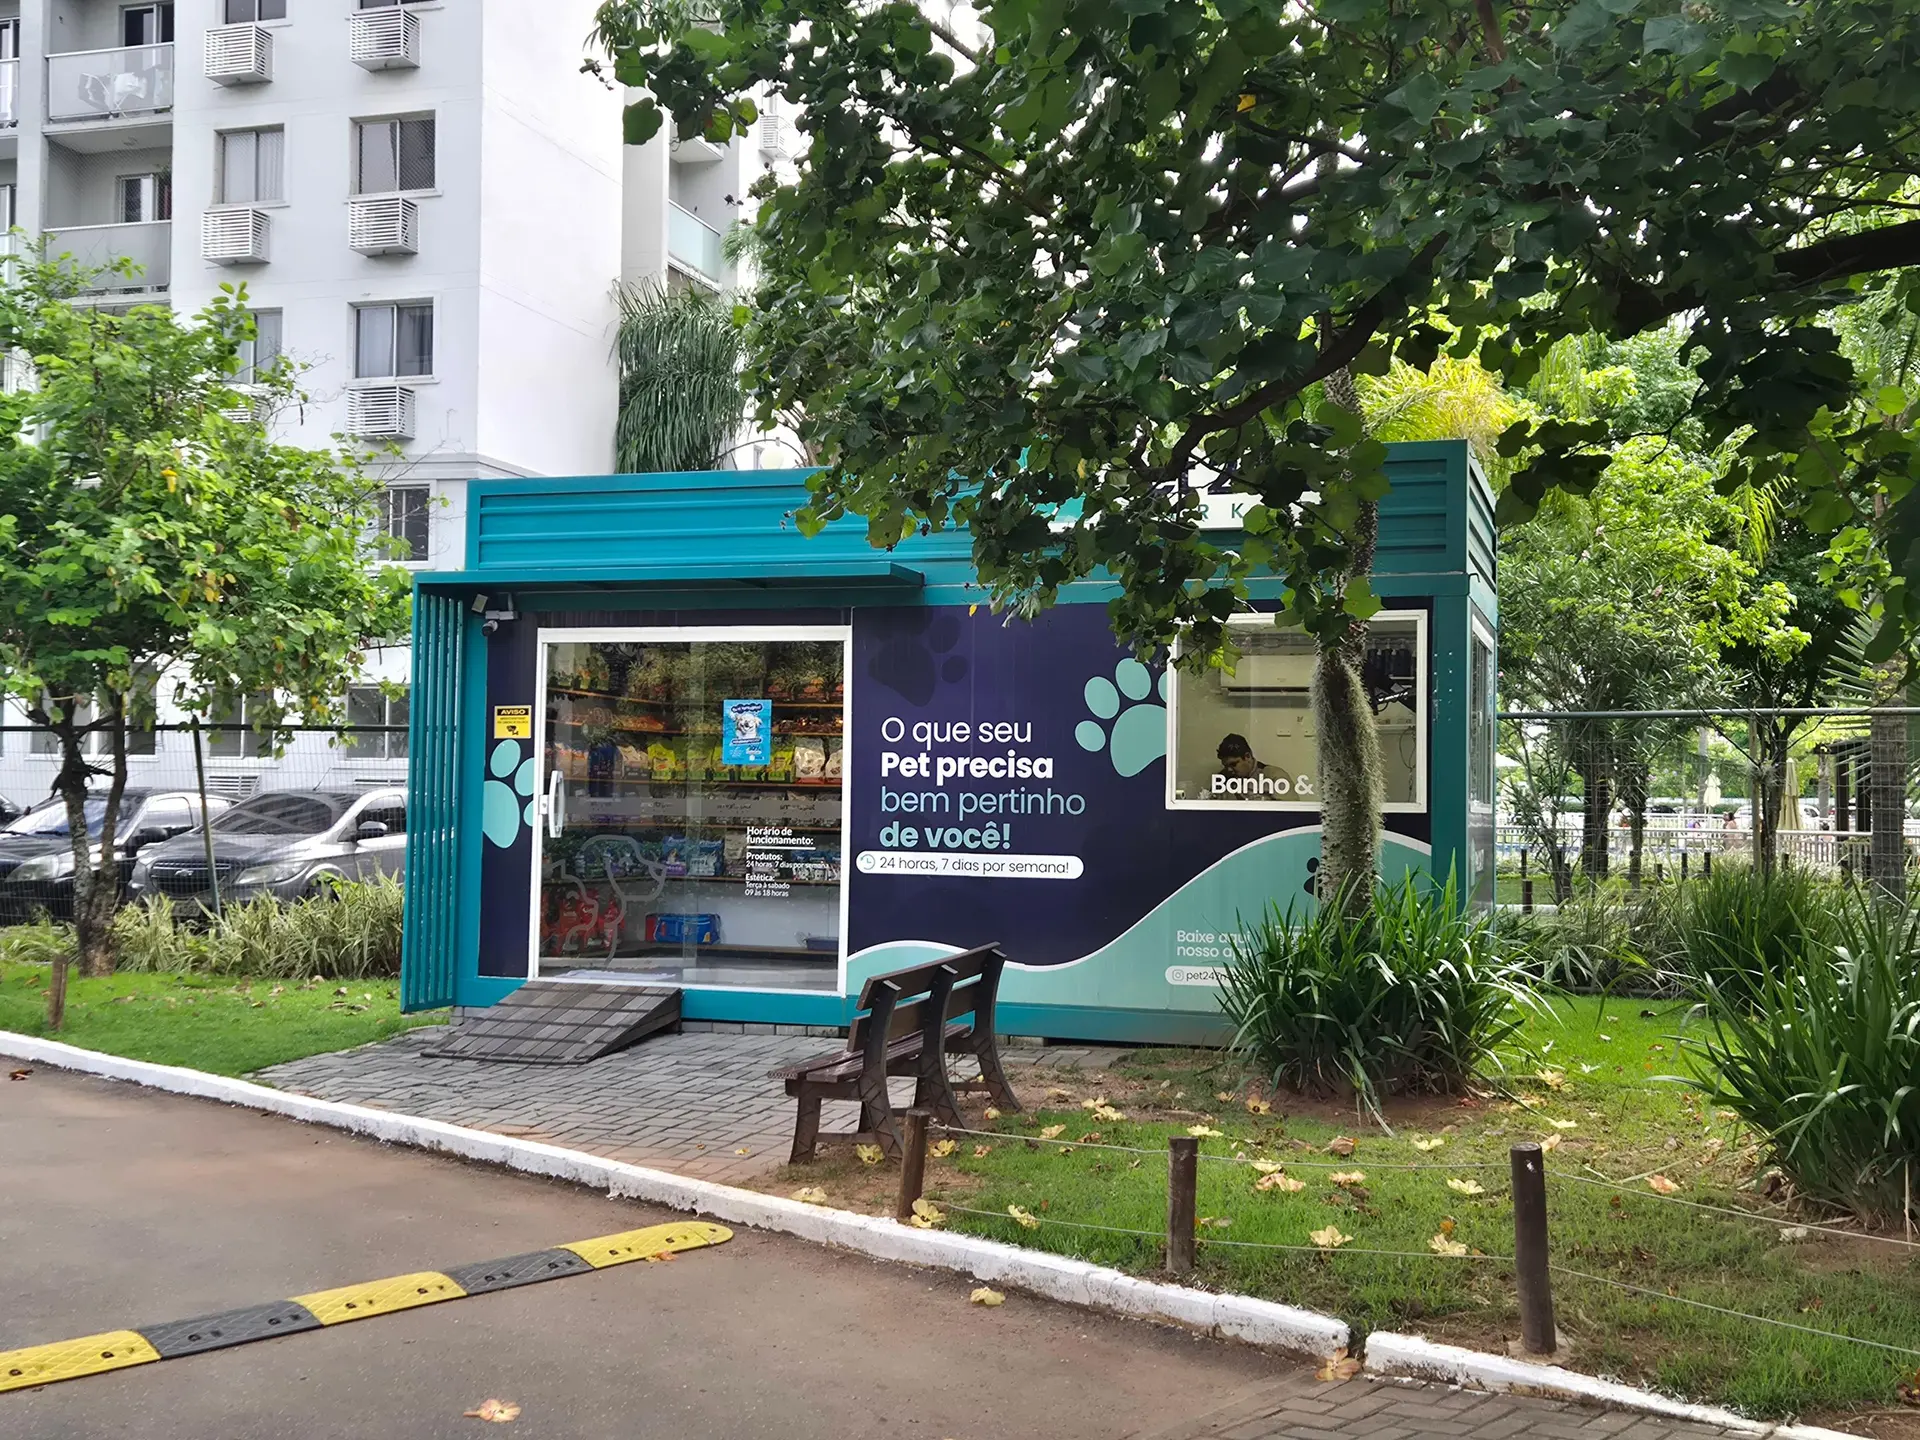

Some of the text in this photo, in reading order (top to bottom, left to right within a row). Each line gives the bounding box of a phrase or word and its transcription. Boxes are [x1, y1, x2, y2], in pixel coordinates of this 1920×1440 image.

[881, 717, 1032, 751] O que seu
[881, 749, 1054, 787] Pet precisa
[1211, 773, 1315, 795] Banho &
[880, 785, 1086, 822] bem pertinho
[746, 826, 792, 836] Horário de
[879, 820, 1012, 850] de você!
[746, 835, 815, 845] funcionamento:
[746, 852, 783, 860] Produtos:
[745, 860, 754, 868] 24
[774, 860, 780, 868] 7
[780, 861, 793, 869] dias
[793, 862, 805, 870] por
[880, 856, 1069, 875] 24 horas, 7 dias por semana!
[745, 873, 776, 882] Estética:
[745, 881, 763, 890] Terça
[744, 888, 754, 896] 09
[762, 889, 771, 897] 18
[771, 889, 789, 898] horas
[1176, 929, 1215, 944] Baixe
[1176, 945, 1220, 958] nosso
